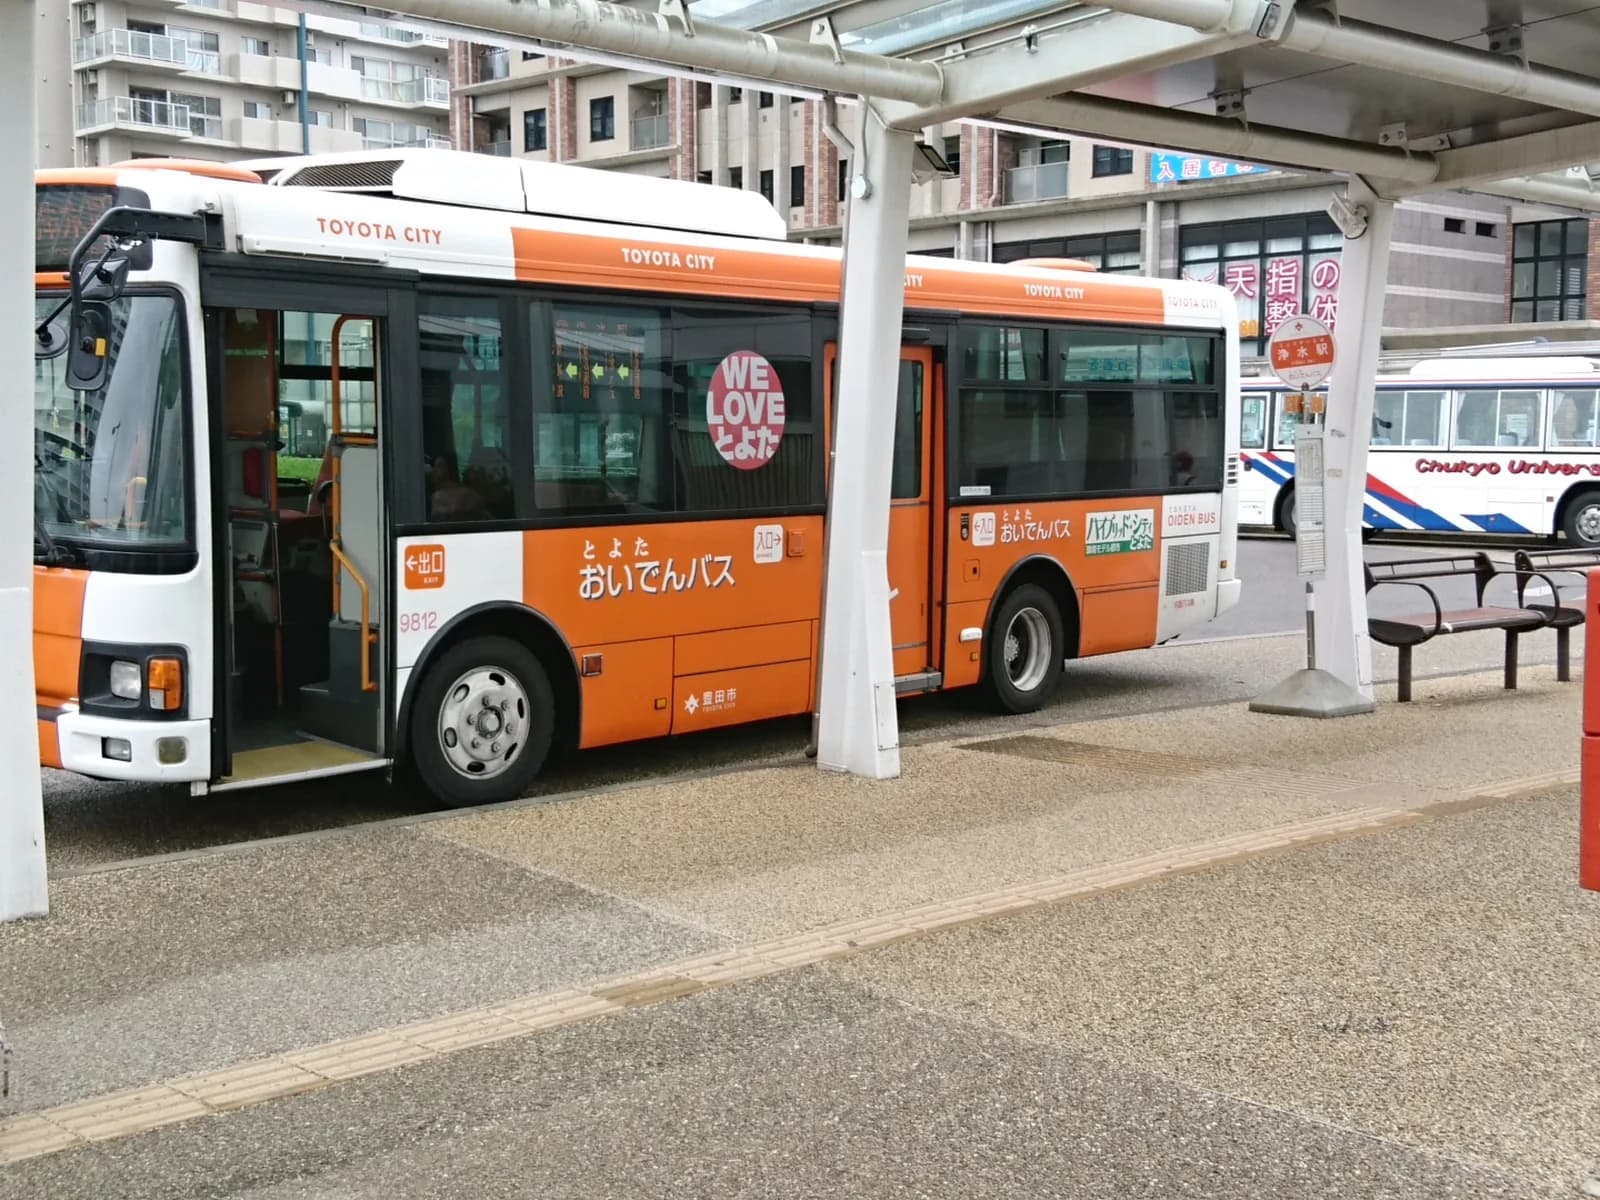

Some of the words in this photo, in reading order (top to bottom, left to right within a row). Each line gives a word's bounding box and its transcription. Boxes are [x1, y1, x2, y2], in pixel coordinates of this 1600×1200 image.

[317, 217, 397, 241] TOYOTA
[404, 226, 442, 246] CITY
[621, 247, 681, 267] TOYOTA
[686, 253, 715, 272] CITY
[1023, 283, 1062, 299] TOYOTA
[1064, 286, 1084, 300] CITY
[721, 355, 769, 390] WE
[706, 390, 786, 425] LOVE
[715, 426, 779, 461] とよた
[1415, 458, 1502, 477] Chukyo
[1002, 508, 1032, 521] とよた
[1168, 513, 1195, 527] OIDEN
[1198, 512, 1216, 525] BUS
[979, 517, 994, 536] 入口
[1000, 519, 1072, 544] おいでんバス
[583, 536, 649, 560] とよた
[756, 531, 774, 550] 入口
[418, 551, 443, 574] 出口
[424, 576, 439, 584] EXIT
[578, 553, 735, 600] おいでんバス
[400, 611, 437, 633] 9812
